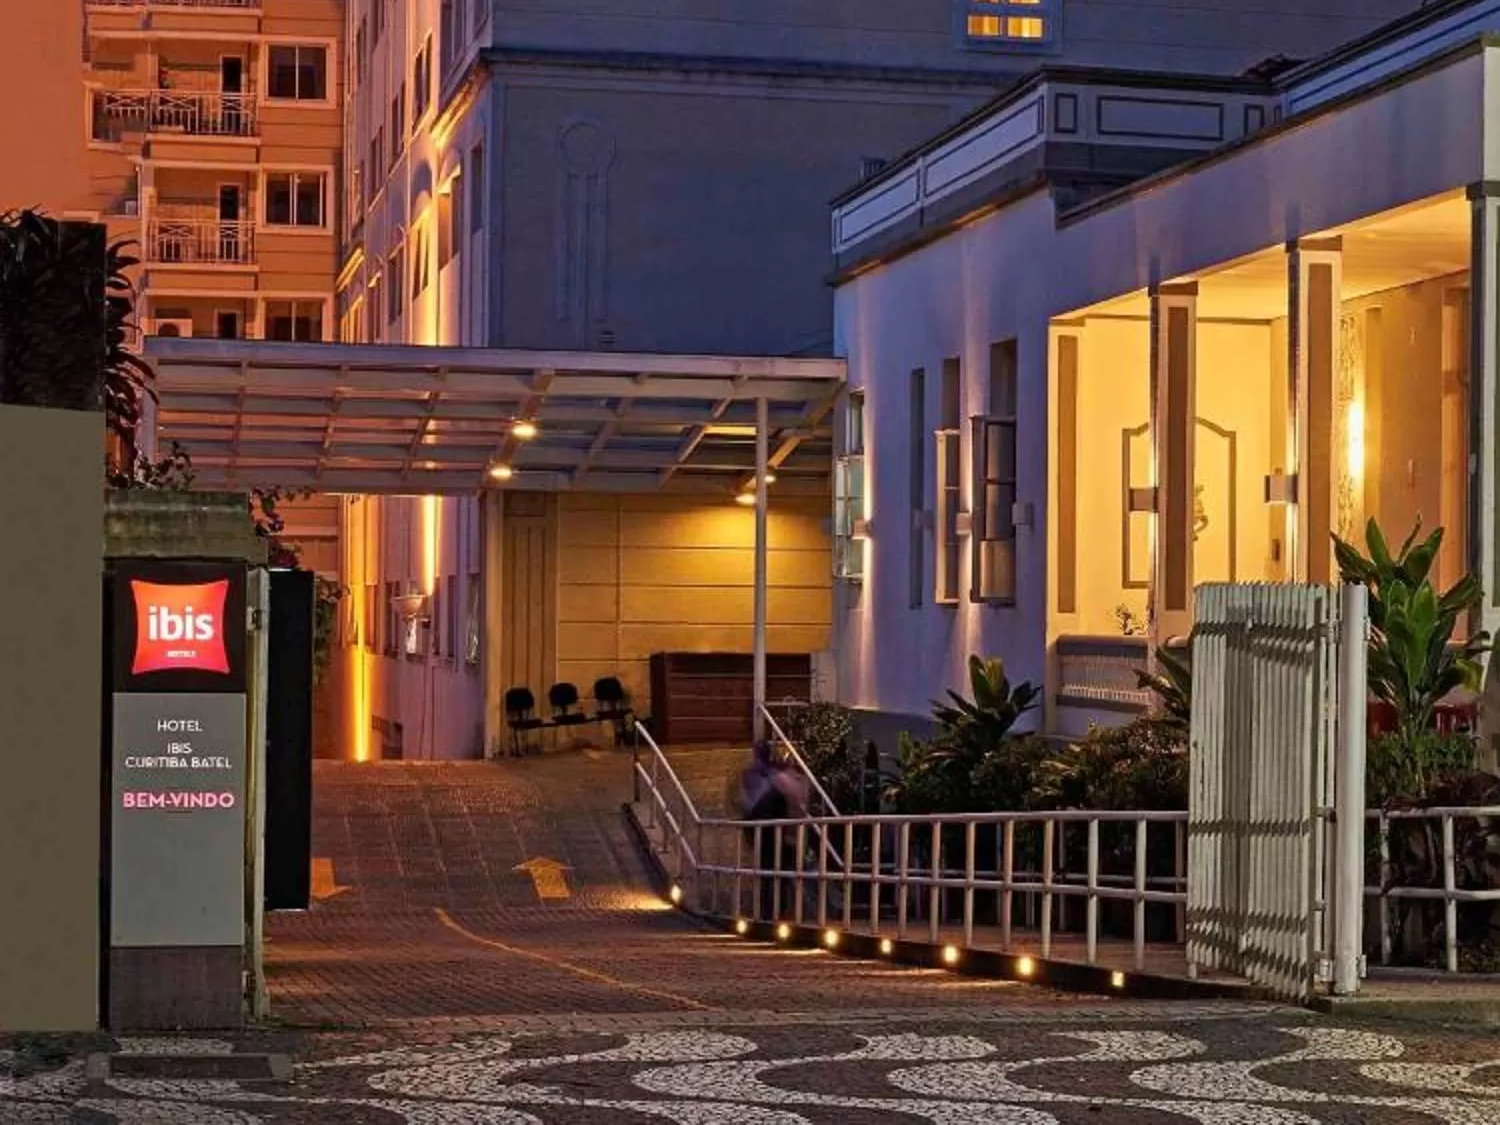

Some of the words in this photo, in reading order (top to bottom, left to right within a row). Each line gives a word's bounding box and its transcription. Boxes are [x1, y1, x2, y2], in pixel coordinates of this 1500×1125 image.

[148, 605, 214, 641] ibis
[156, 719, 203, 732] HOTEL
[167, 742, 193, 754] IBIS
[125, 756, 189, 768] CURITIBA
[190, 756, 233, 769] BATEL
[122, 792, 235, 808] BEM-VINDO
